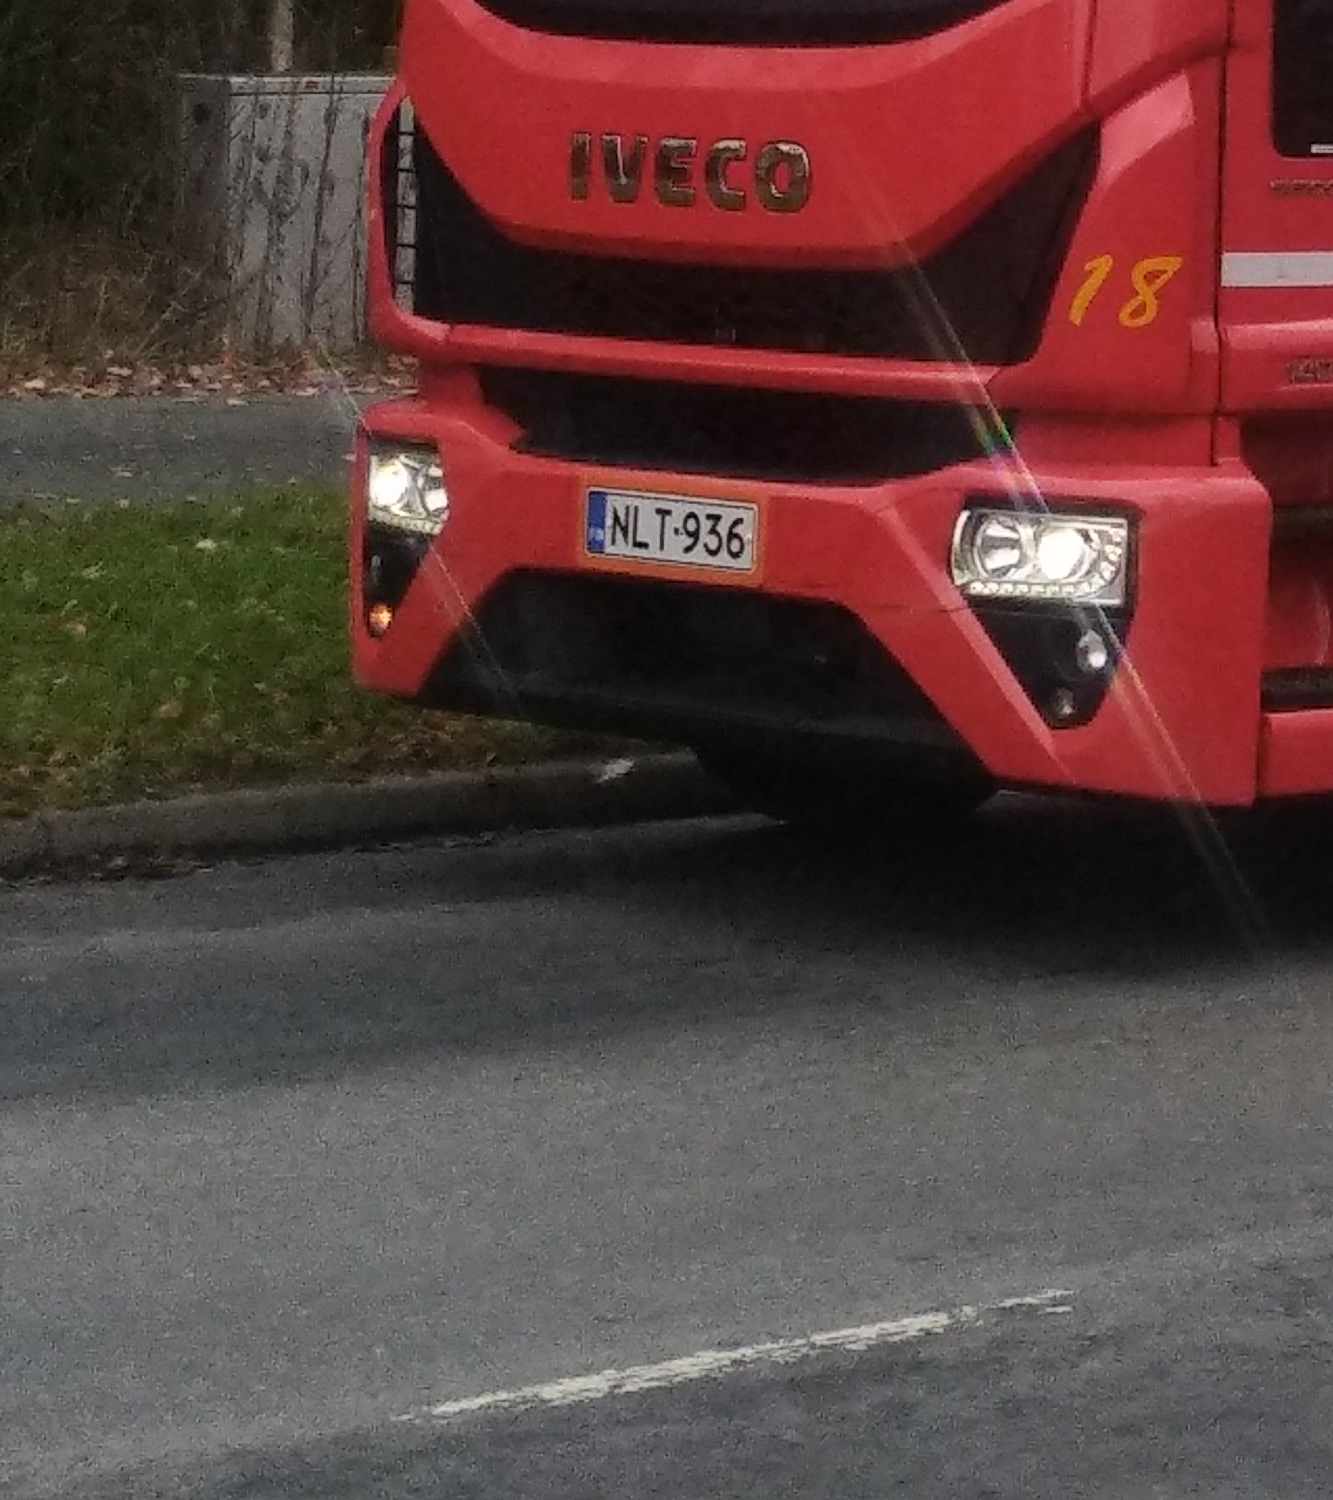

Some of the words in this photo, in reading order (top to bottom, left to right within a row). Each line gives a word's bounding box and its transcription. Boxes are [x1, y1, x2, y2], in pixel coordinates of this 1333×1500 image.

[569, 131, 813, 213] IVECO
[1068, 254, 1183, 328] 18
[610, 504, 746, 560] NLT-936
